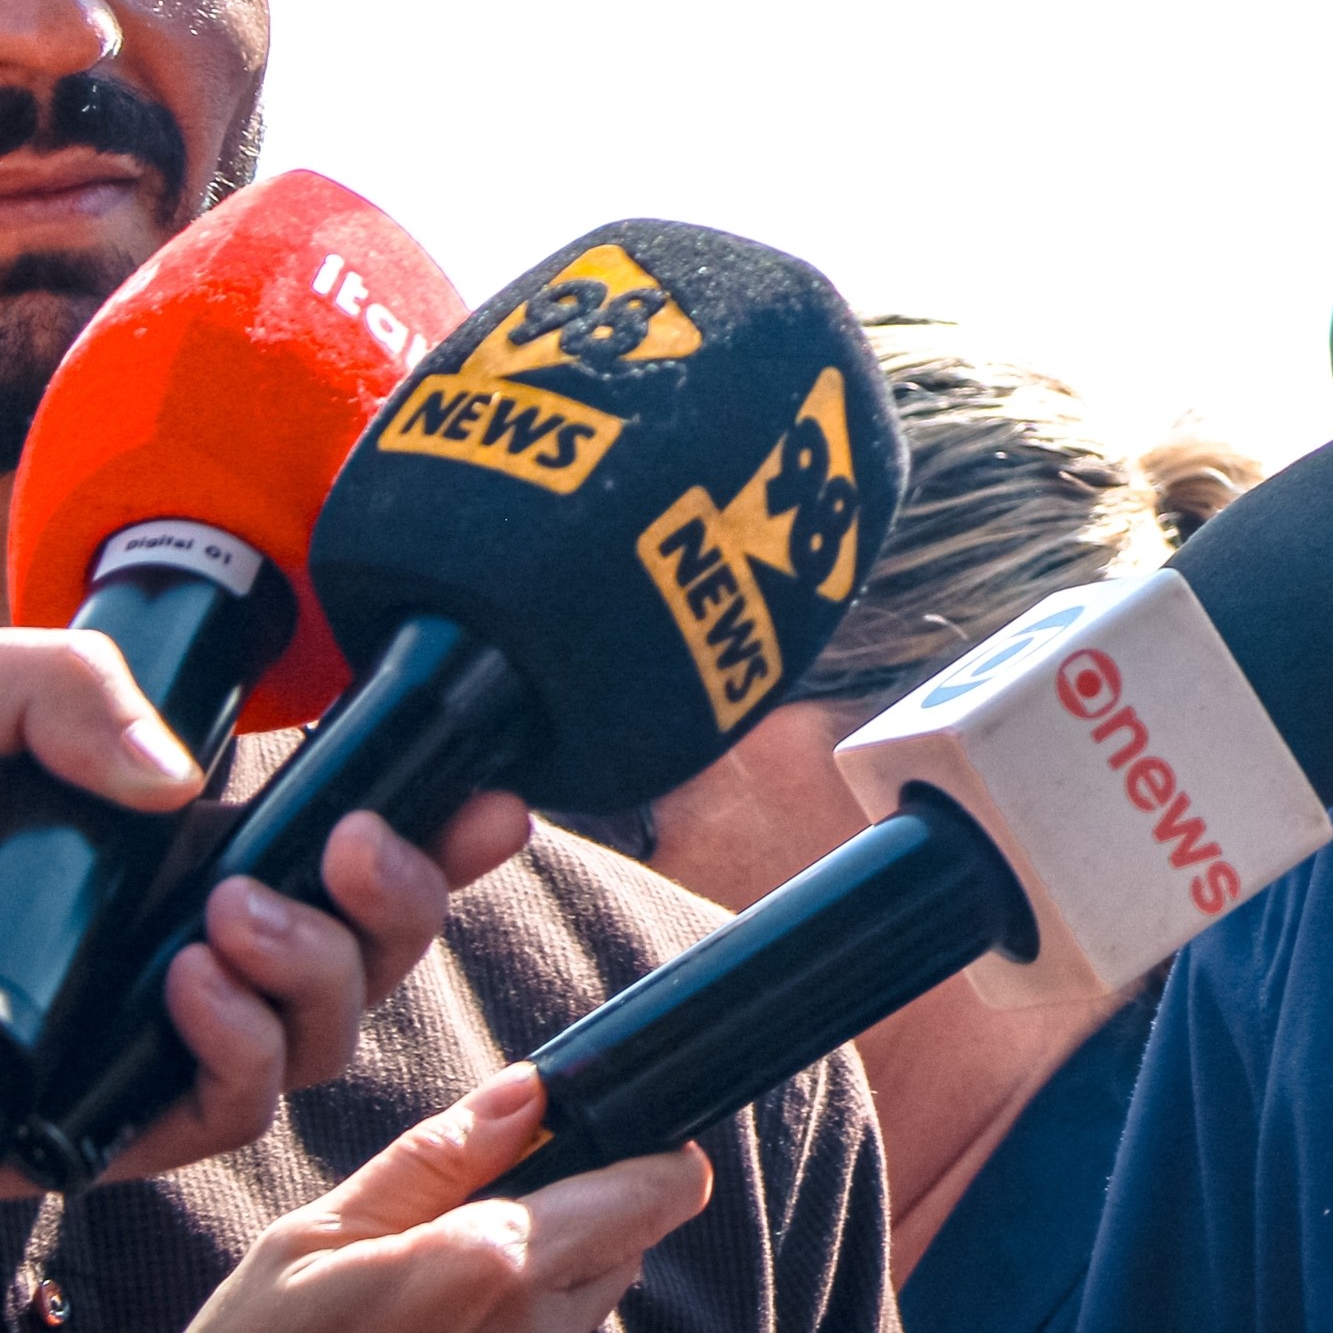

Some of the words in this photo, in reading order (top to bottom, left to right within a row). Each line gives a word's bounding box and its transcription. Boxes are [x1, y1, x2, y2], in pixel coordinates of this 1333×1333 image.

[508, 279, 668, 369] 98
[400, 390, 597, 469] NEWS
[125, 535, 194, 551] Digital
[765, 415, 859, 591] 98
[659, 516, 768, 703] NEWS
